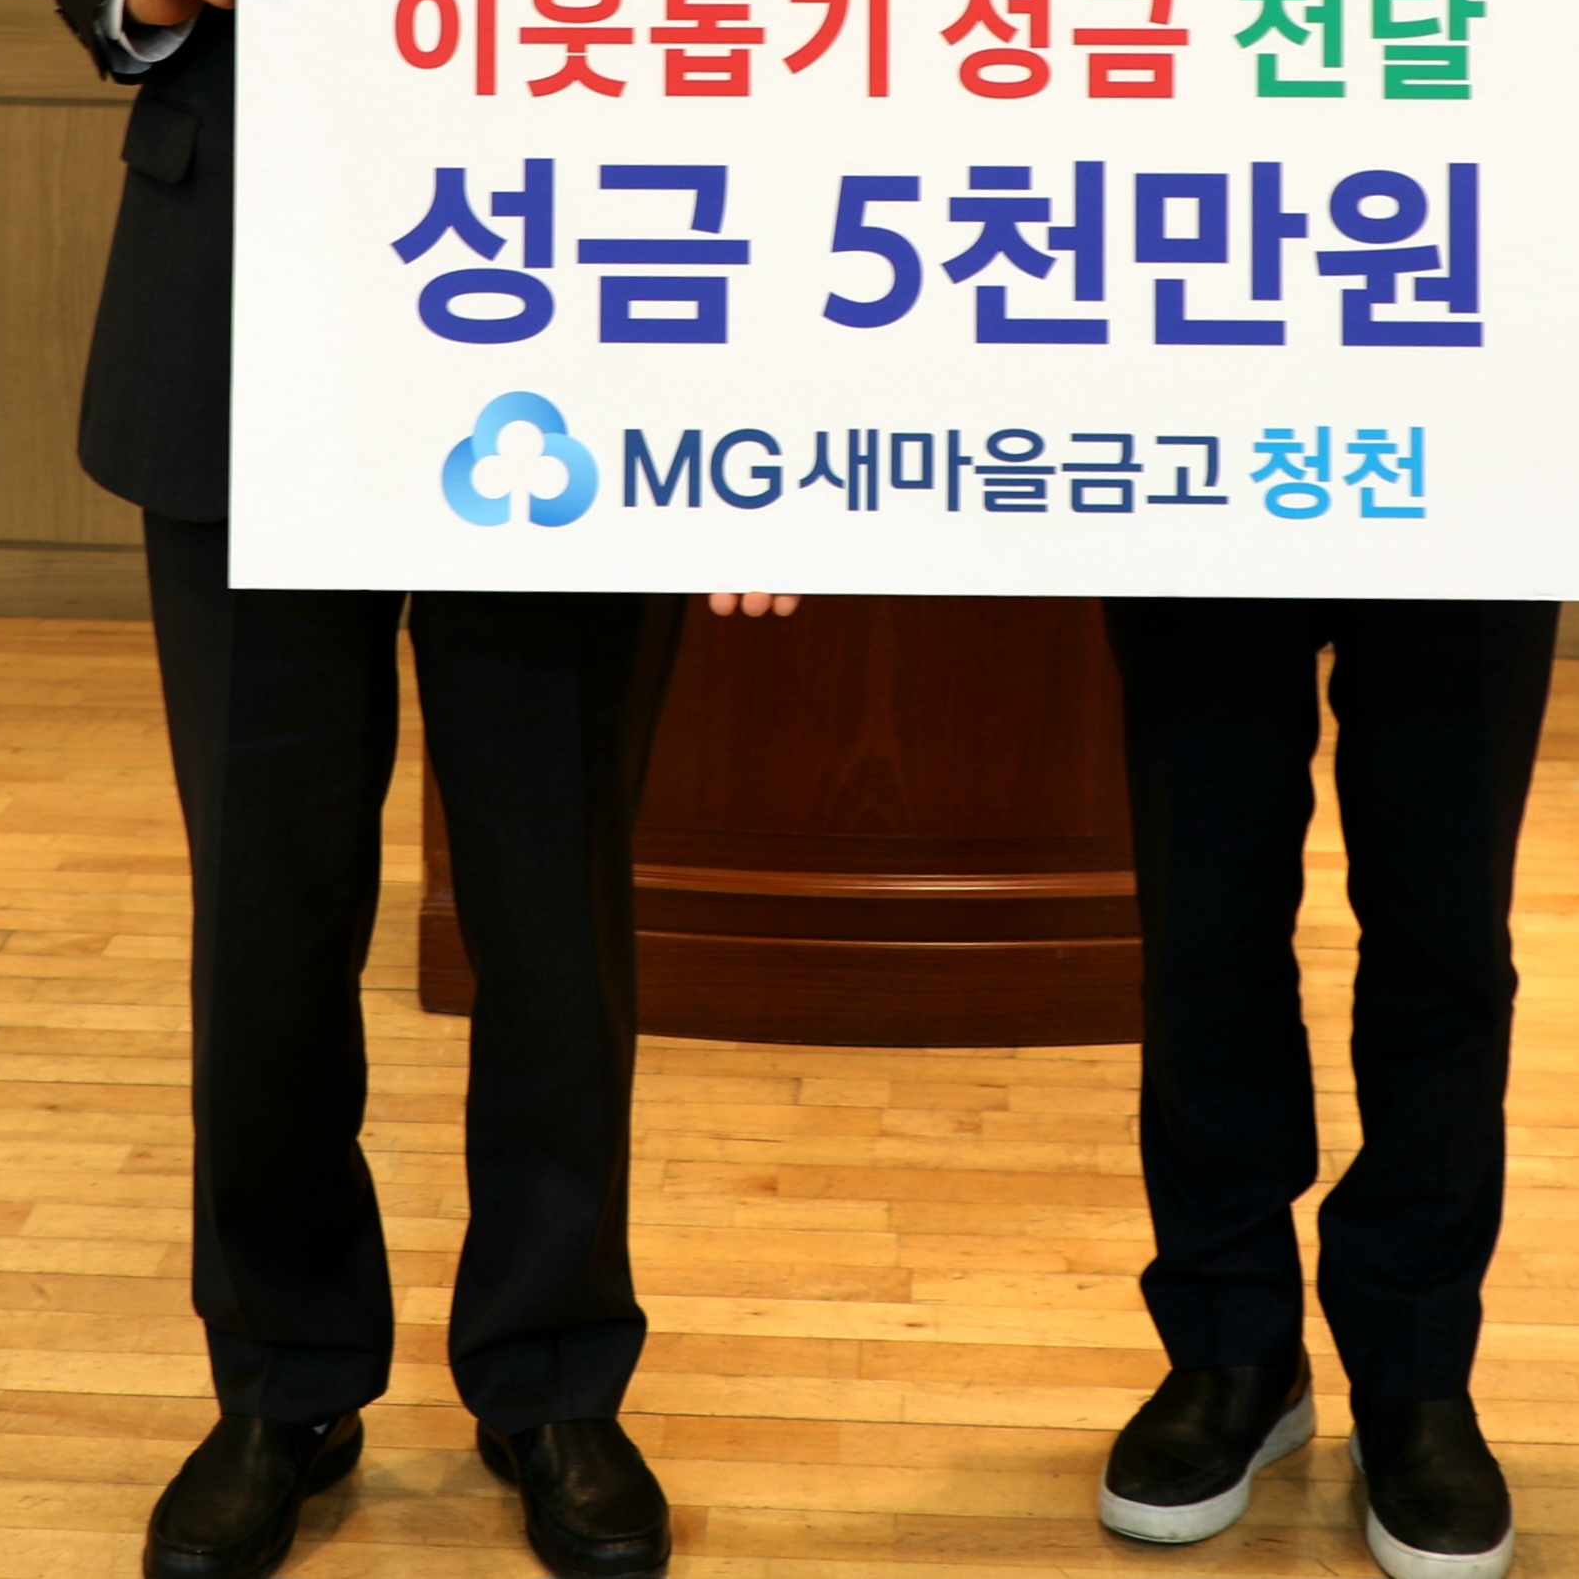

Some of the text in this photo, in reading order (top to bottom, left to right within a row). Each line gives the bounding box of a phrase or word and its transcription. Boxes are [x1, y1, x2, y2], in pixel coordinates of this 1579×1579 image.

[389, 157, 1484, 348] 성금 5천만원
[1249, 425, 1427, 521] 청천
